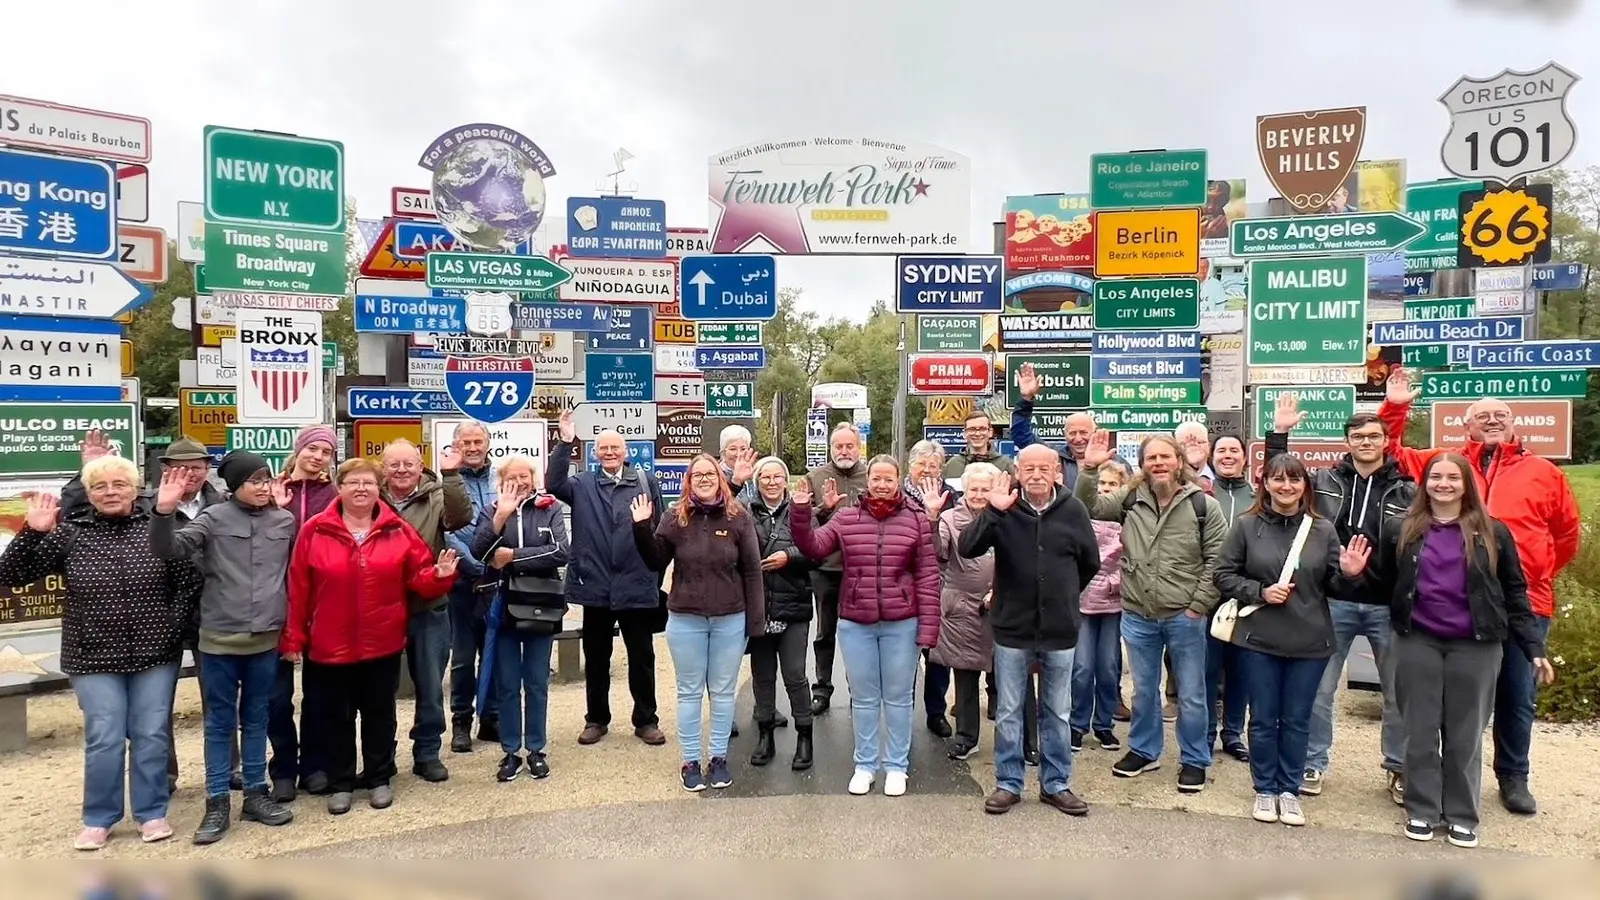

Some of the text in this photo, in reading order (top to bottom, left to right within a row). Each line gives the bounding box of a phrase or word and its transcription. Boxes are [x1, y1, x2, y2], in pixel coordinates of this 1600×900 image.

[1462, 79, 1554, 105] OREGON
[29, 123, 141, 150] du Palais Bourbon
[1266, 123, 1356, 149] BEVERLY
[424, 126, 552, 174] For a peaceful world
[719, 137, 907, 165] Herzlich Willkommen Welcome Bienvenue
[1465, 122, 1551, 171] 101
[1097, 161, 1200, 175] Rio de Janeiro
[1279, 151, 1341, 173] HILLS
[216, 157, 335, 190] NEW YORK
[40, 181, 107, 210] Kong
[0, 207, 78, 243] 香港
[1244, 220, 1376, 241] Los Angeles
[1470, 205, 1539, 248] 66
[223, 229, 271, 248] Times
[275, 233, 329, 254] Square
[818, 231, 957, 248] www.fernweh-park.de
[1116, 227, 1178, 245] Berlin
[1243, 244, 1265, 252] Santa
[1267, 242, 1296, 251] Monica
[1323, 240, 1343, 249] West
[1344, 239, 1387, 249] Hollywood
[1010, 253, 1091, 264] Mount Rushmore
[1108, 251, 1138, 260] Bezirk
[236, 252, 316, 278] Broadway
[434, 259, 554, 278] LAS VEGAS Miles
[434, 276, 523, 288] Downtown Las Vegas
[741, 268, 769, 287] دبي
[904, 264, 999, 284] SYDNEY
[1007, 273, 1092, 291] WELCOME TO
[1267, 270, 1347, 290] MALIBU
[1532, 267, 1555, 281] ton
[243, 278, 310, 292] New York City
[574, 279, 670, 296] NIÑODAGUIA
[219, 293, 335, 310] KANSAS CITY CHIEFS
[722, 291, 769, 306] Dubai
[917, 290, 984, 303] CITY LIMIT
[1099, 288, 1127, 300] Los
[1129, 286, 1194, 302] Angeles
[1499, 296, 1520, 307] ELVIS
[364, 299, 457, 318] N Broadway
[515, 303, 608, 320] Tennessee Av
[1116, 308, 1176, 318] CITY LIMITS
[1254, 302, 1301, 321] CITY
[1305, 300, 1361, 320] LIMIT
[1405, 304, 1462, 319] NEWPORT
[264, 316, 293, 328] THE
[391, 317, 399, 328] N
[922, 319, 977, 332] CAÇADOR
[1001, 315, 1060, 331] WATSON
[241, 329, 320, 346] BRONX
[606, 333, 632, 341] PEACE
[1380, 322, 1516, 340] Malibu Beach Dr
[439, 339, 539, 354] ELVIS PRESLEY BLVD
[939, 341, 964, 349] Brasil
[1098, 334, 1165, 350] Hollywood
[1167, 333, 1196, 348] Blvd
[1254, 340, 1359, 354] Pop. 13,000 Elev. 17
[712, 351, 759, 365] Aşgabat
[1477, 346, 1593, 364] Pacific Coast
[457, 360, 523, 372] INTERSTATE
[929, 364, 973, 377] PRAHA
[1107, 361, 1184, 376] Sunset Blvd
[1426, 373, 1581, 395] Sacramento WAY
[464, 381, 519, 406] 278
[596, 388, 643, 397] Jerusalem
[1103, 384, 1188, 402] Palm Springs
[1328, 389, 1347, 402] CA
[63, 418, 129, 431] BEACH
[1030, 415, 1038, 425] A
[1121, 410, 1169, 427] Canyon
[1172, 410, 1207, 424] Drive
[616, 424, 645, 435] Gedi
[2, 433, 75, 445] Playa Icacos
[1529, 434, 1555, 442] Miles
[40, 443, 55, 452] de
[24, 604, 63, 618] AFRICA
